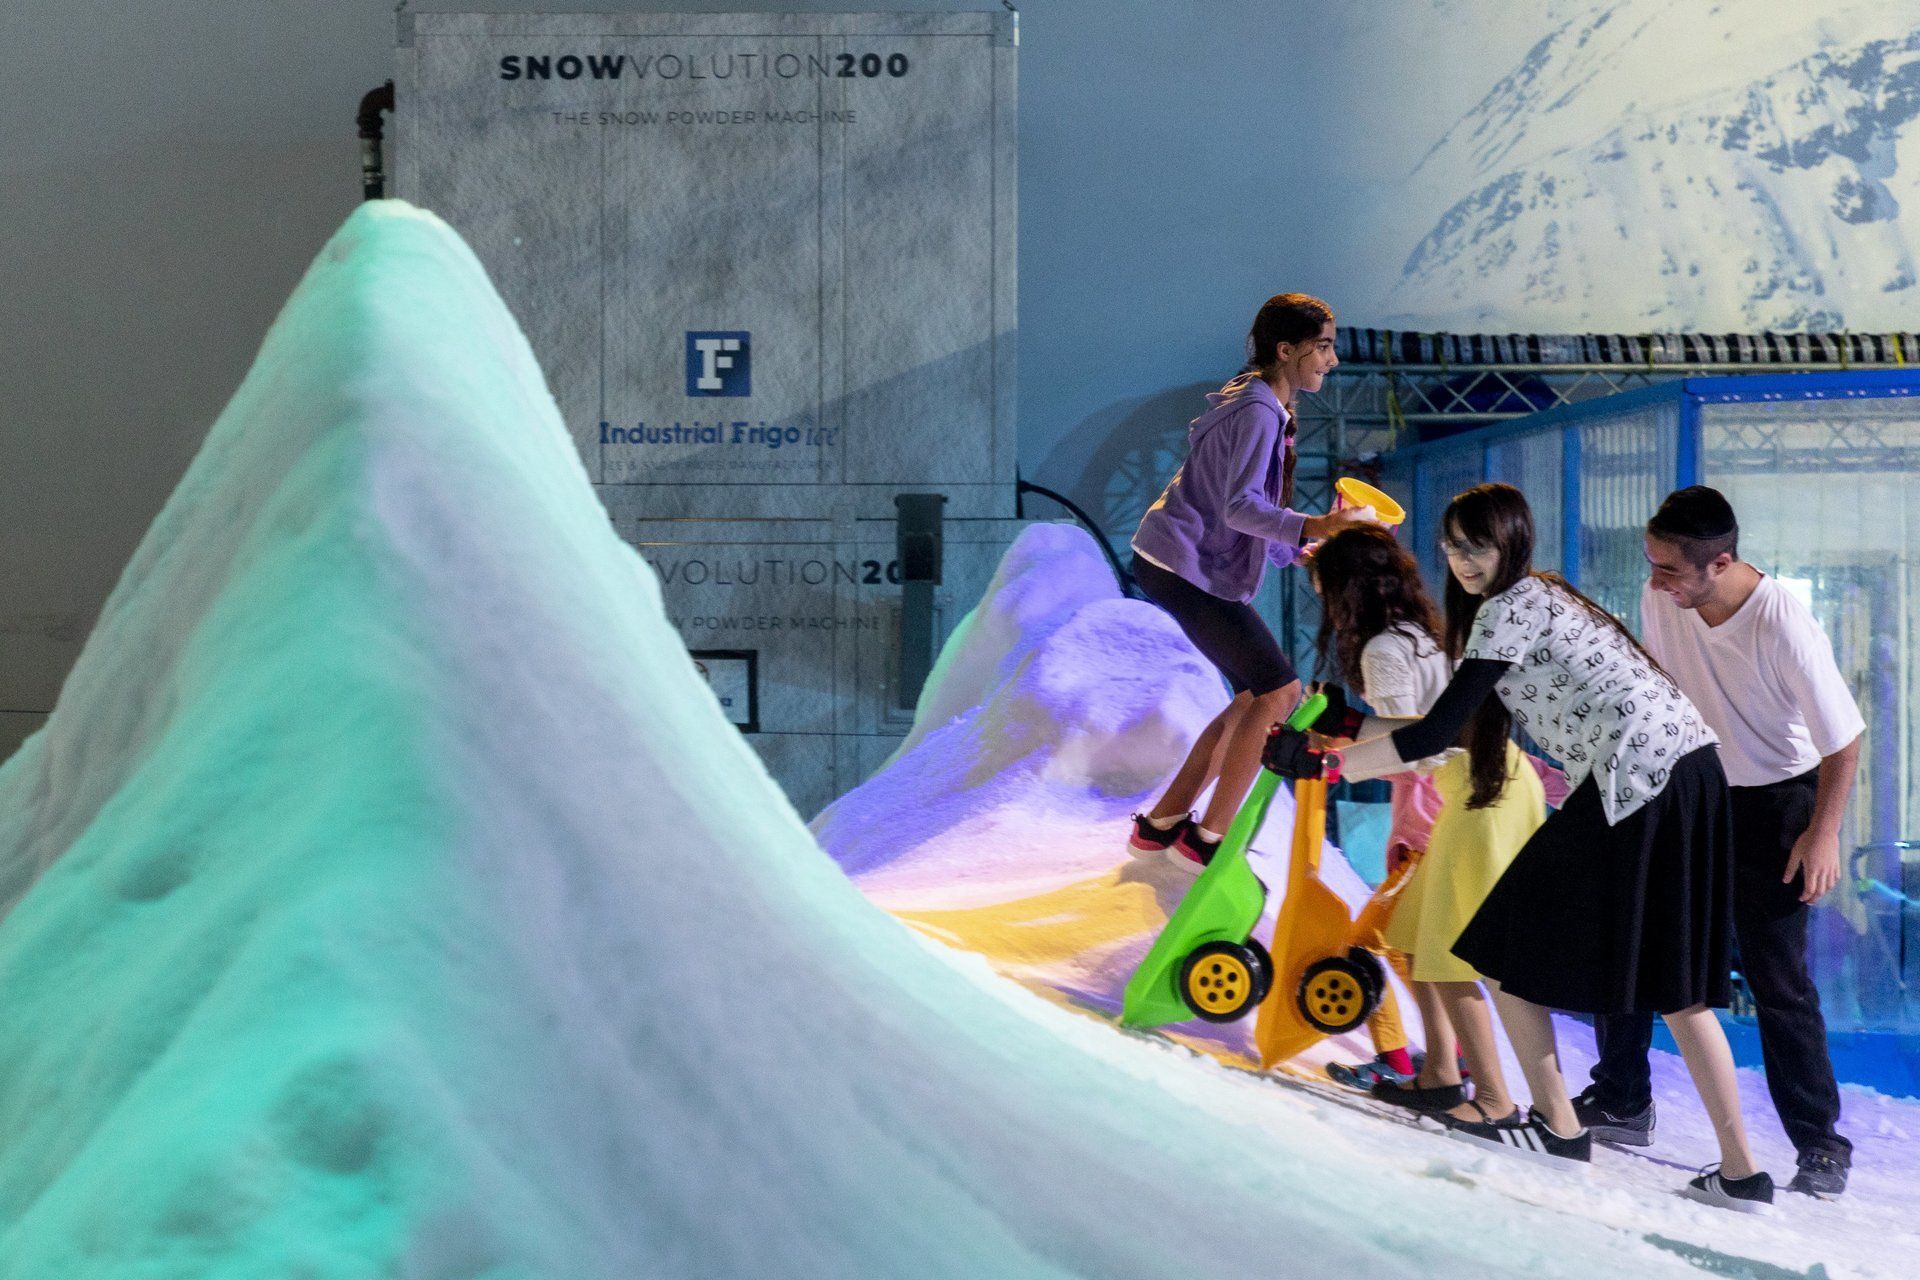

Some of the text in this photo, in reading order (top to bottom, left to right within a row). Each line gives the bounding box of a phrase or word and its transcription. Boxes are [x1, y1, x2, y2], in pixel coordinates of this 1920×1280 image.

[499, 52, 909, 81] SNOWVOLUTION200
[553, 109, 856, 125] THE SNOW POWDER MACHINE
[599, 421, 723, 444] Industrial
[731, 421, 800, 449] Frigo
[647, 556, 902, 585] VOLUTION20
[692, 616, 781, 630] POWDER
[789, 616, 880, 630] MACHINE
[1528, 647, 1552, 667] XO
[1584, 651, 1605, 671] XO
[1520, 683, 1538, 704] XO
[1550, 673, 1570, 693] XO
[1613, 700, 1636, 721] XO
[1627, 732, 1650, 754] XO
[1614, 786, 1634, 809] XO
